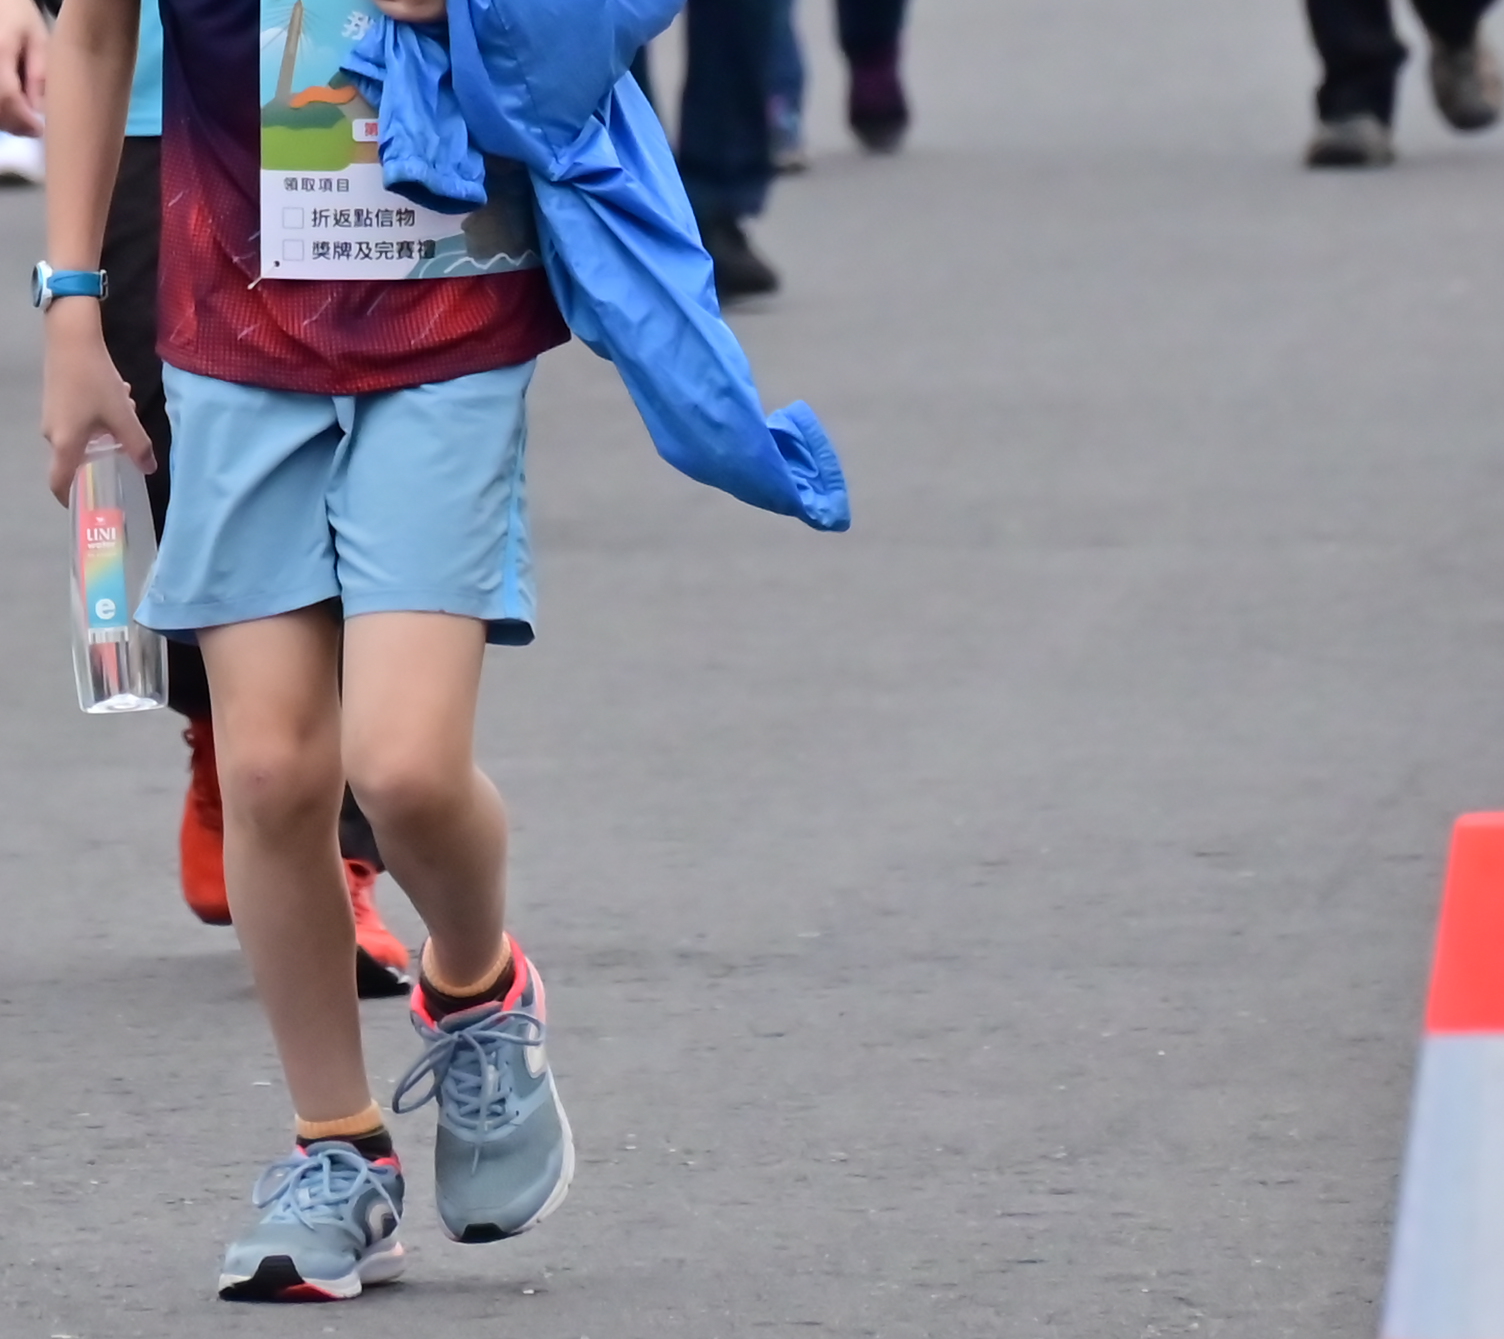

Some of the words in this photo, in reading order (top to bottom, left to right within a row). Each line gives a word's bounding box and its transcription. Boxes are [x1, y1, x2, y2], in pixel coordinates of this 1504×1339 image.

[283, 177, 350, 193] 領取項目
[311, 207, 416, 228] 折返點信物
[312, 239, 437, 260] 獎牌及完賽禮
[86, 527, 117, 542] UNI
